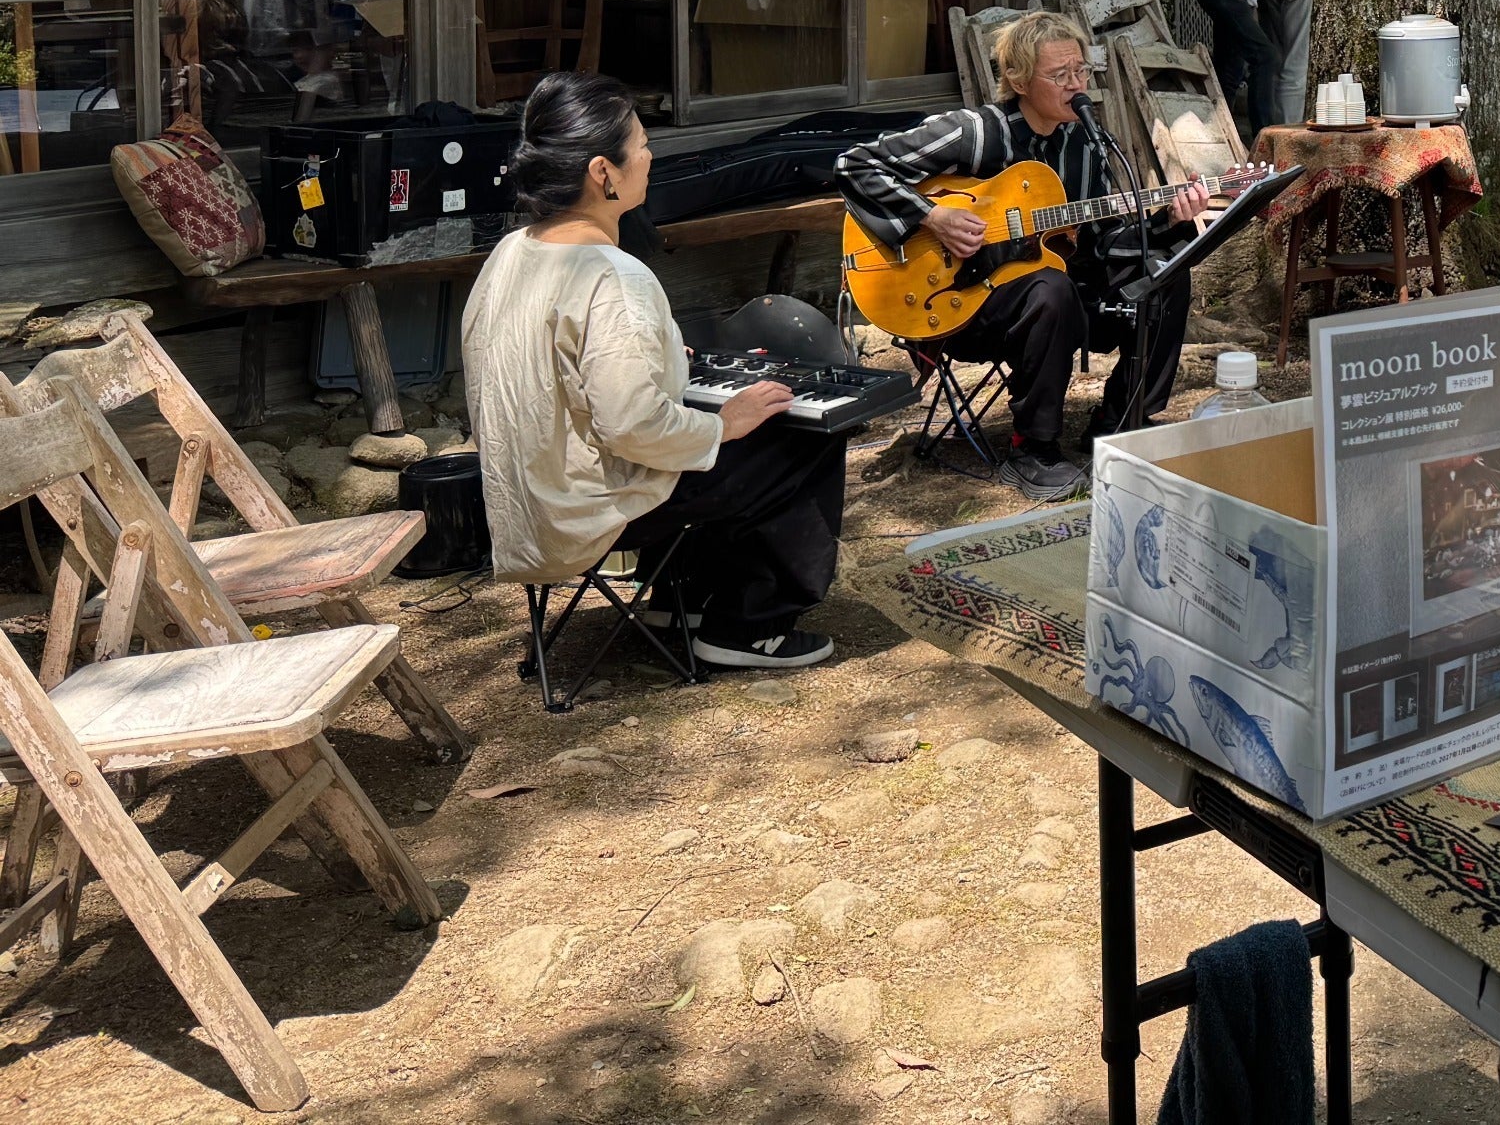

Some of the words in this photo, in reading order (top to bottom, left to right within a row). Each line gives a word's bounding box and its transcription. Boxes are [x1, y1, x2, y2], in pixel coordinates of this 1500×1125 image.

[1340, 353, 1422, 382] moon
[1431, 333, 1497, 368] book
[1451, 375, 1489, 390] 予約受付中
[1340, 382, 1438, 410] 夢雲ビジュアルブック
[1341, 412, 1394, 431] コレクション展
